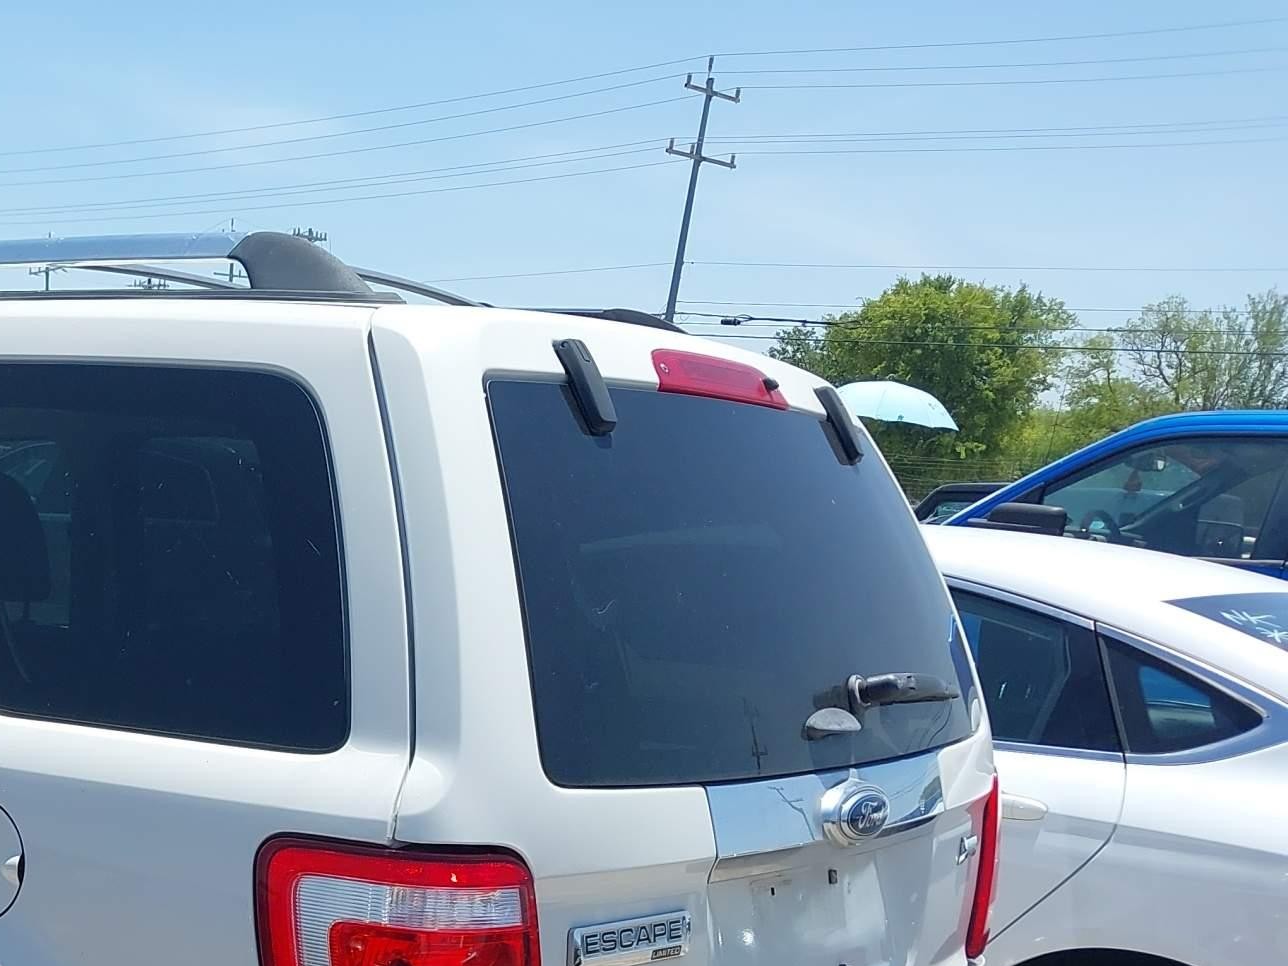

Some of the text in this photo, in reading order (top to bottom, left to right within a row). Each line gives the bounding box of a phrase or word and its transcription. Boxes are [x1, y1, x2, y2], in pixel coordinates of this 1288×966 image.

[857, 801, 888, 829] Ford
[583, 920, 682, 955] ESCAPE
[652, 946, 681, 959] LIMITED
